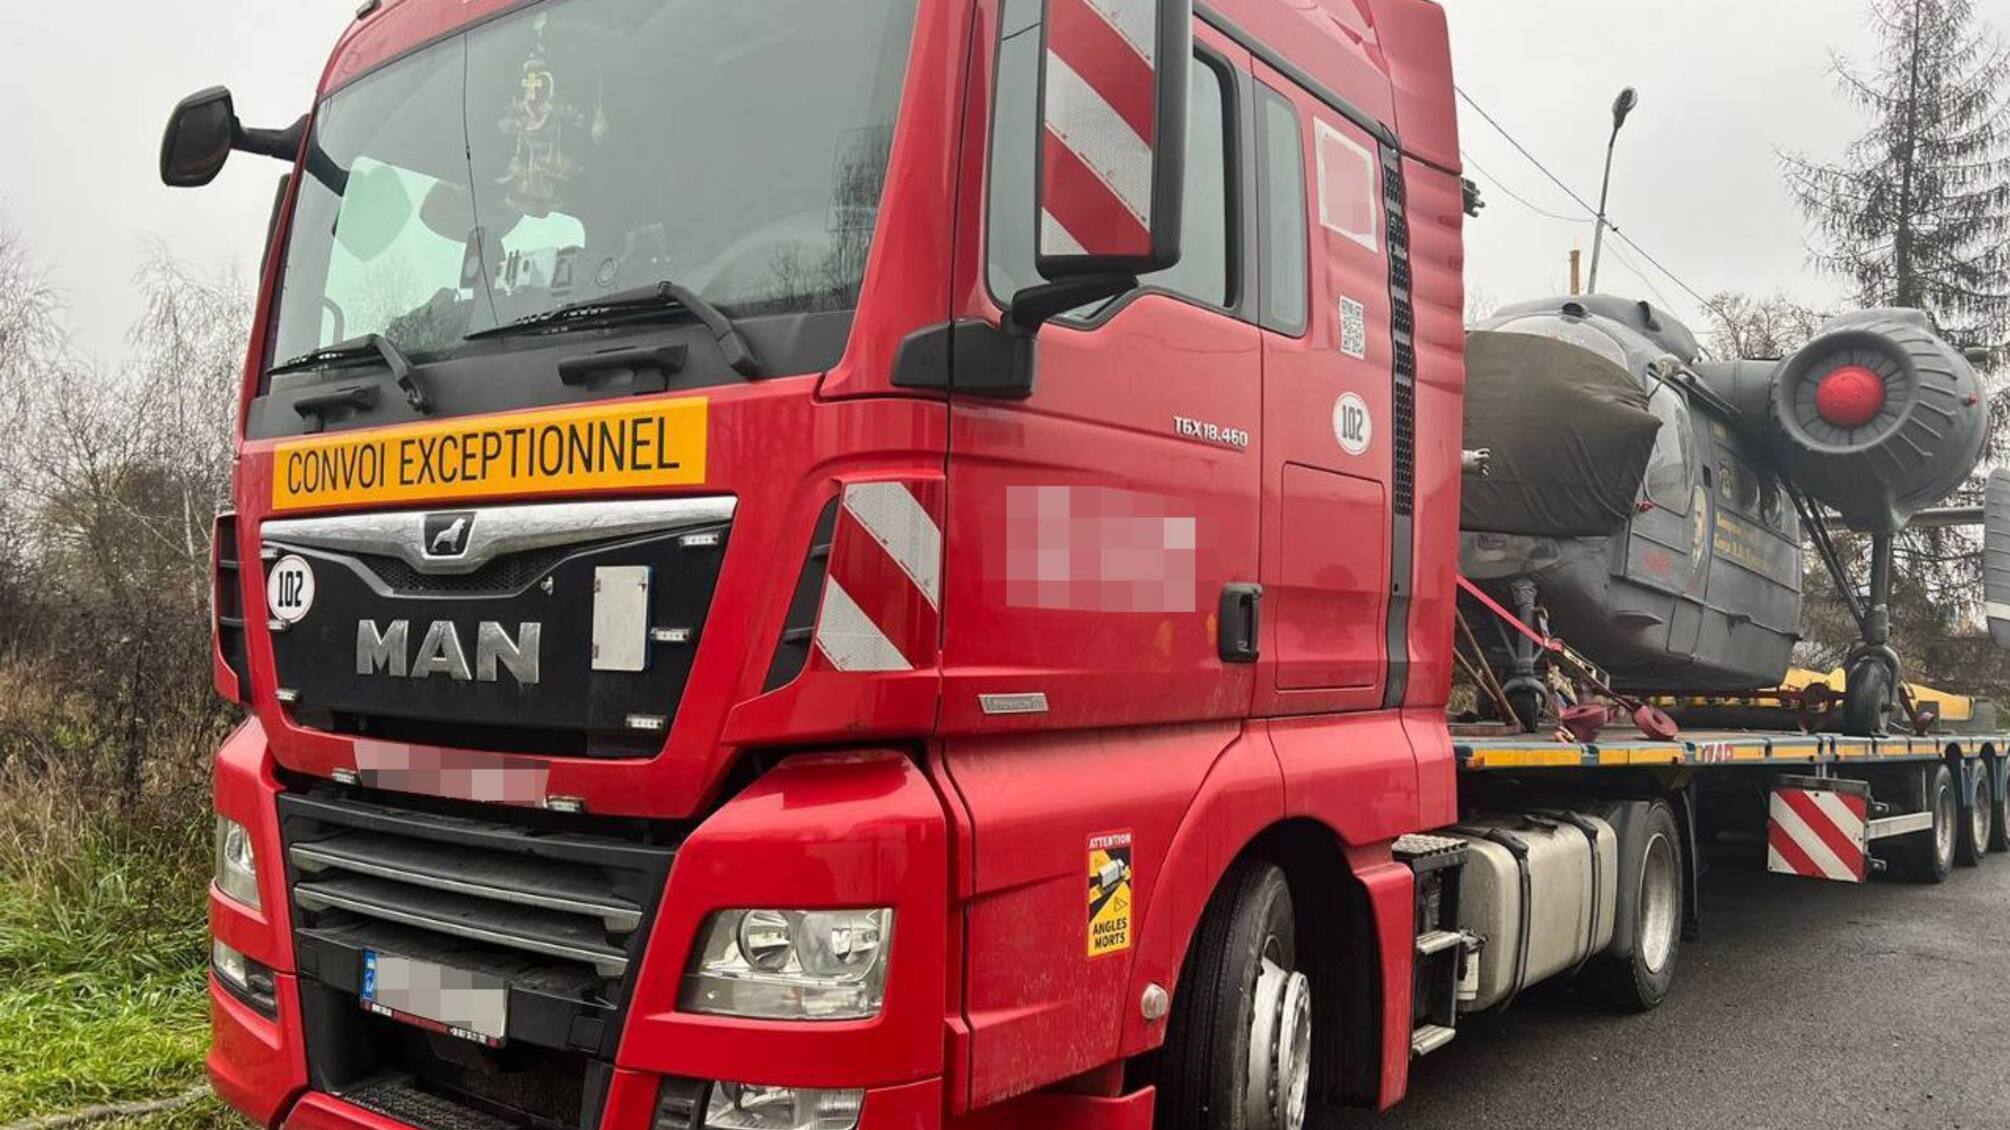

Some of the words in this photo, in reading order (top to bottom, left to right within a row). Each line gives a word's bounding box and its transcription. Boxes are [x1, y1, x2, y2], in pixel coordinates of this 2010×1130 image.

[1342, 404, 1363, 442] 102
[287, 443, 385, 495] CONVOI
[399, 416, 680, 485] EXCEPTIONNEL
[278, 571, 303, 607] 102
[356, 619, 541, 684] MAN
[1089, 833, 1132, 849] ATTENTION
[1093, 918, 1128, 936] ANGLES
[1094, 932, 1126, 951] MORTS
